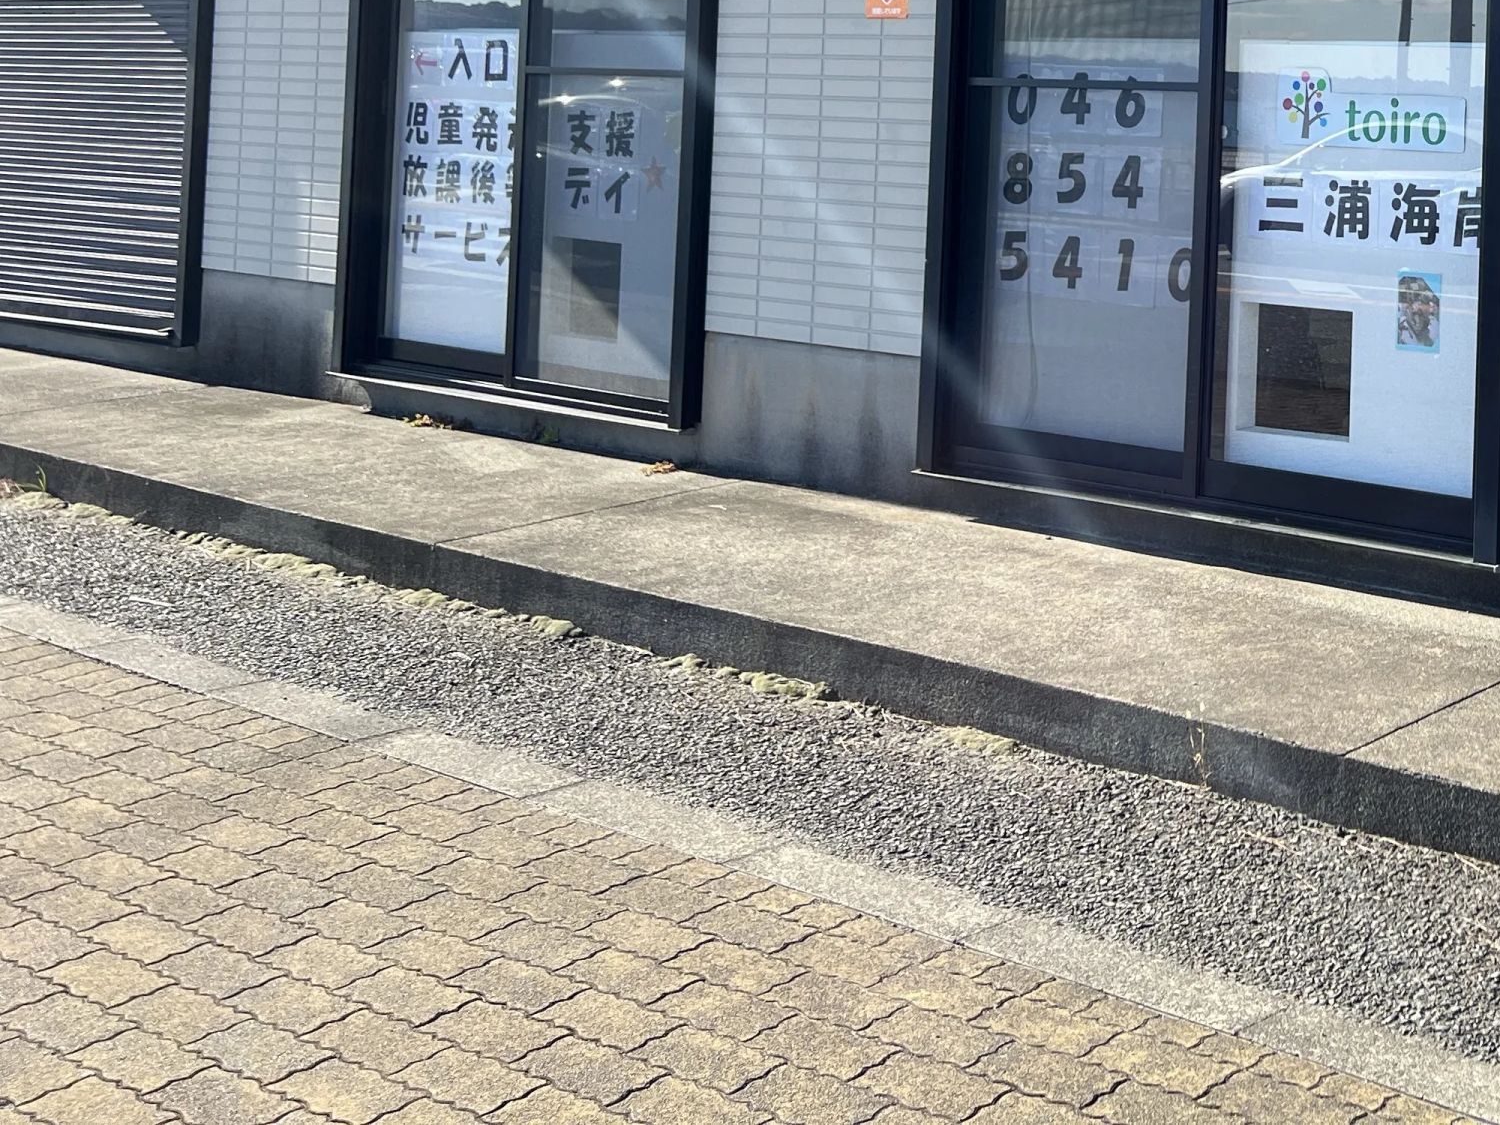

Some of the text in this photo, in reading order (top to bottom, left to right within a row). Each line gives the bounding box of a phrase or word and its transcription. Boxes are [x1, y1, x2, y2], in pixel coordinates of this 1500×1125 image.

[447, 37, 508, 82] 入口
[1007, 72, 1146, 129] 046
[1345, 97, 1447, 146] toiro
[566, 109, 635, 159] 支援
[564, 166, 632, 214] デイ
[1002, 152, 1144, 210] 854
[999, 230, 1192, 303] 5410
